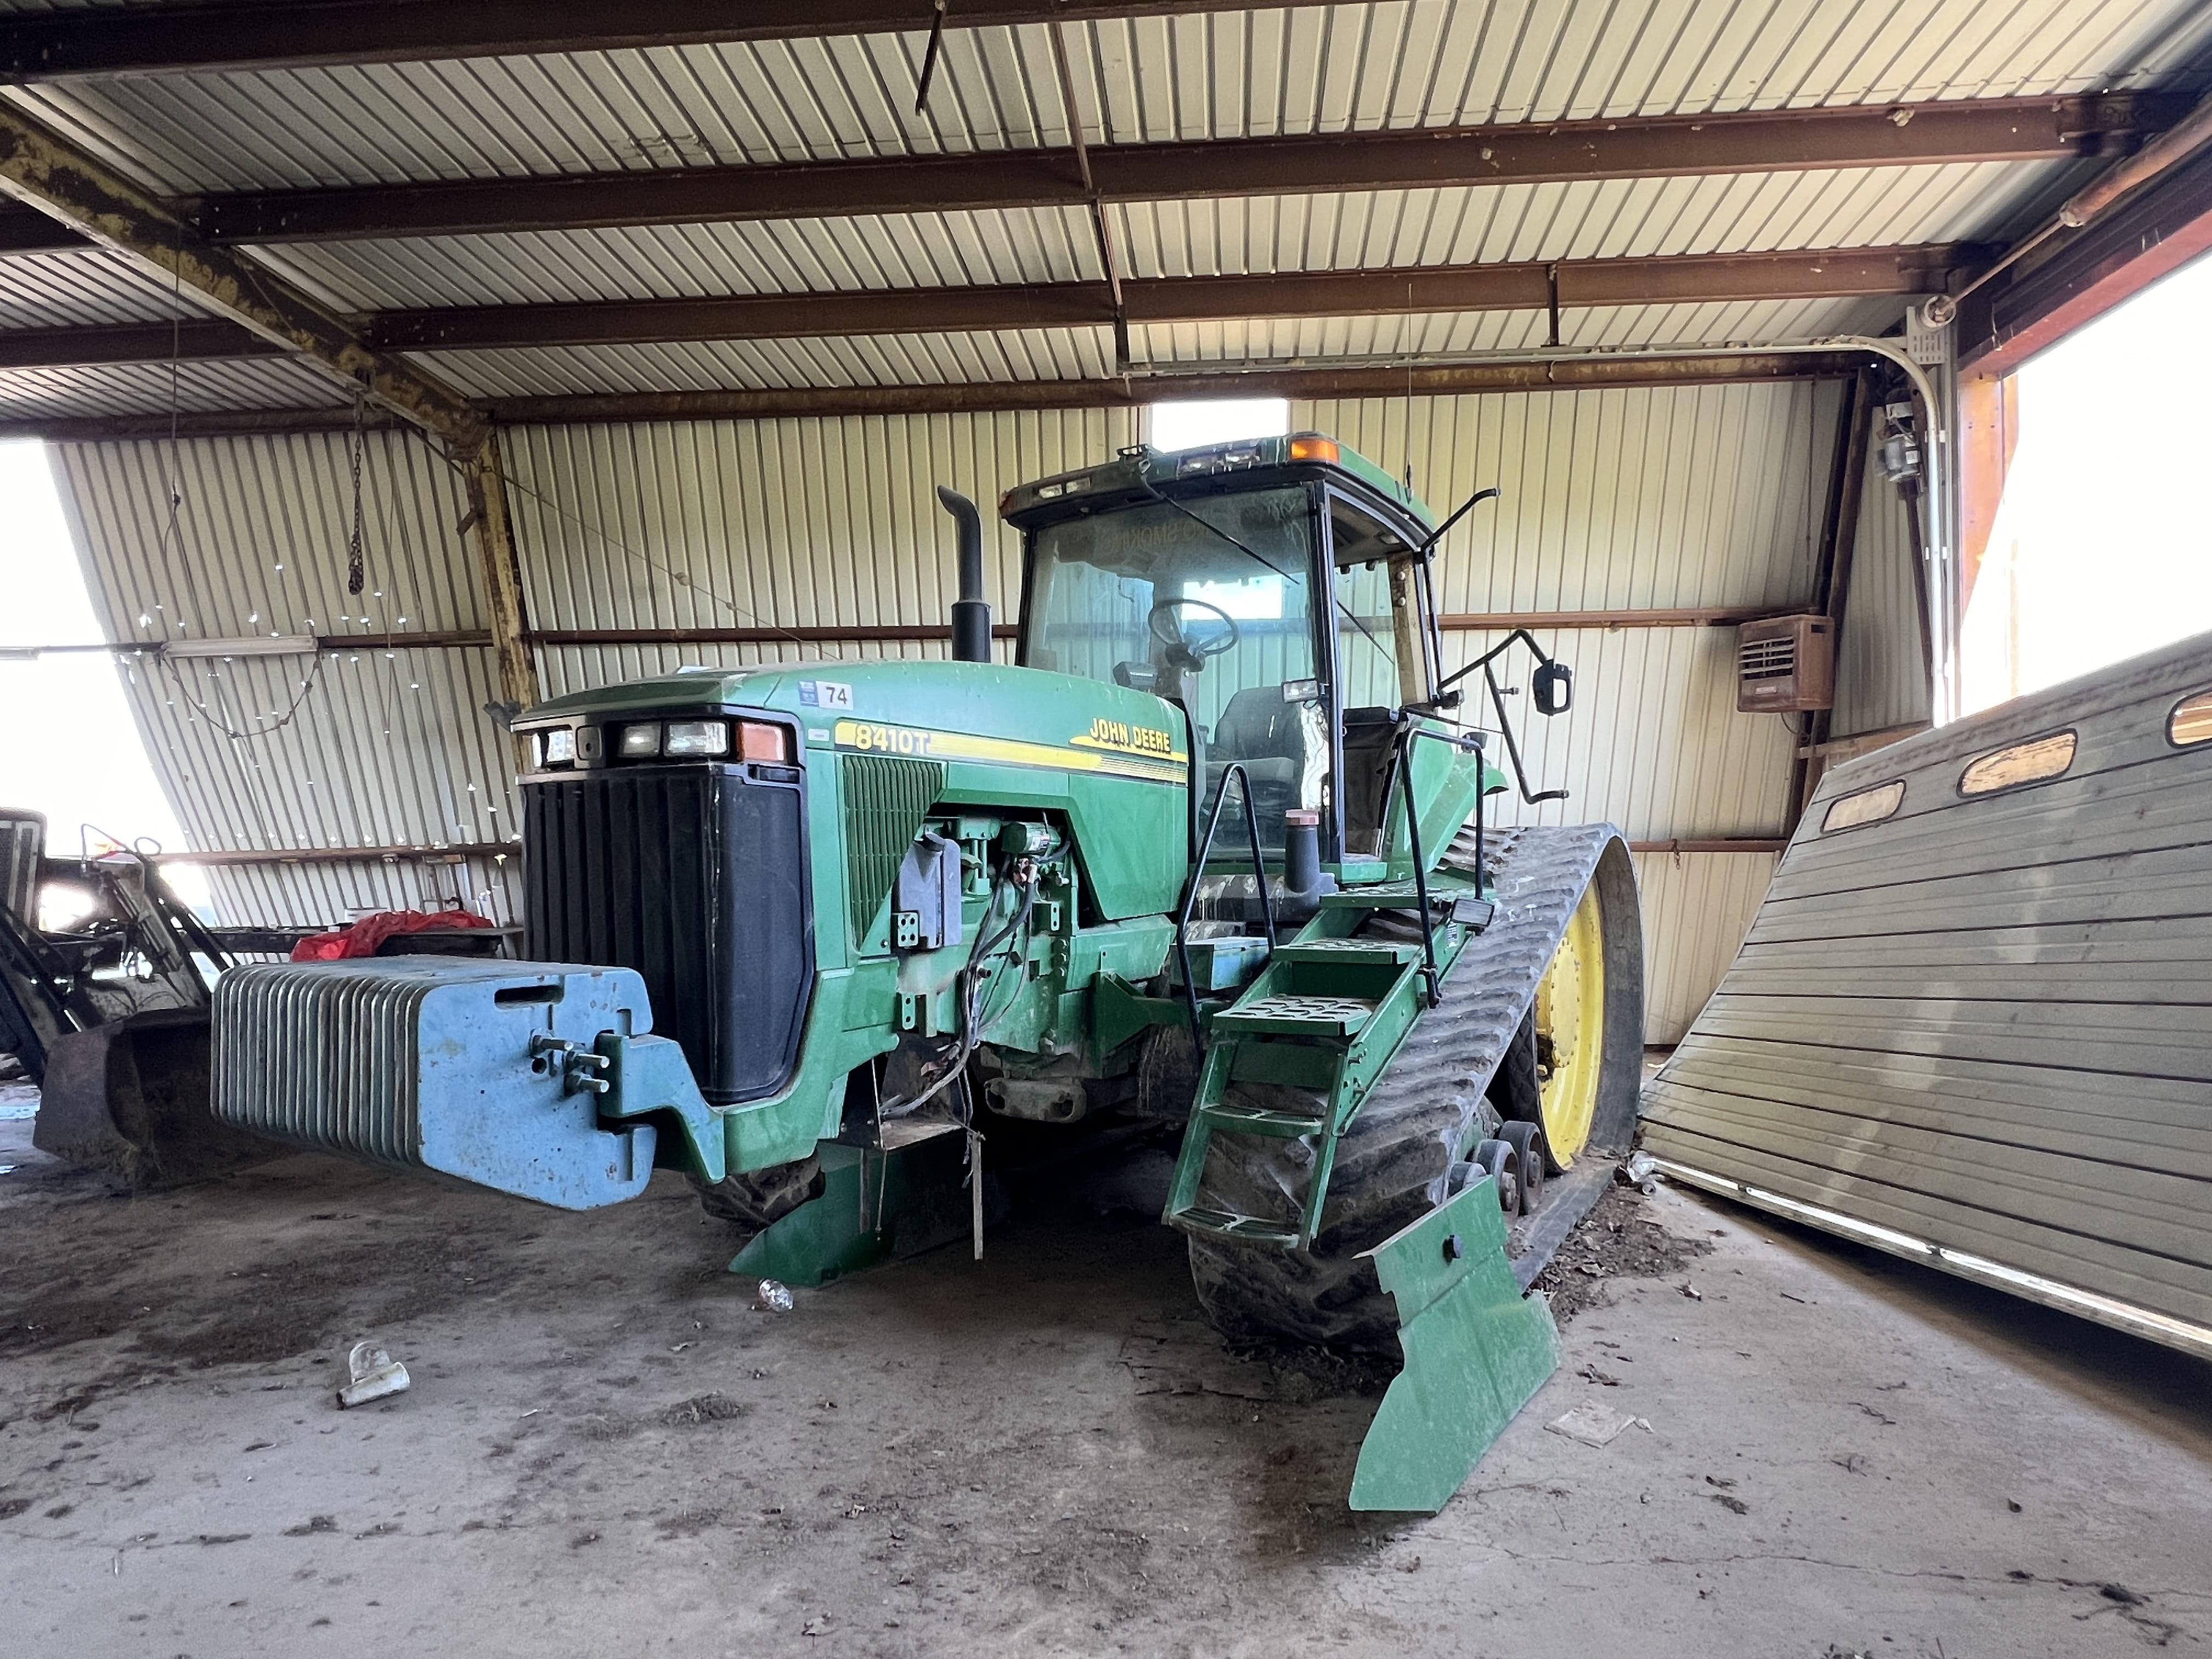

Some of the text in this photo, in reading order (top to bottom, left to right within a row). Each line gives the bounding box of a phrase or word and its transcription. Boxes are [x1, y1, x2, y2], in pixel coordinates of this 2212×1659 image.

[826, 686, 847, 704] 74
[855, 724, 929, 754] 8410T
[1090, 717, 1171, 753] JOHN DEERE
